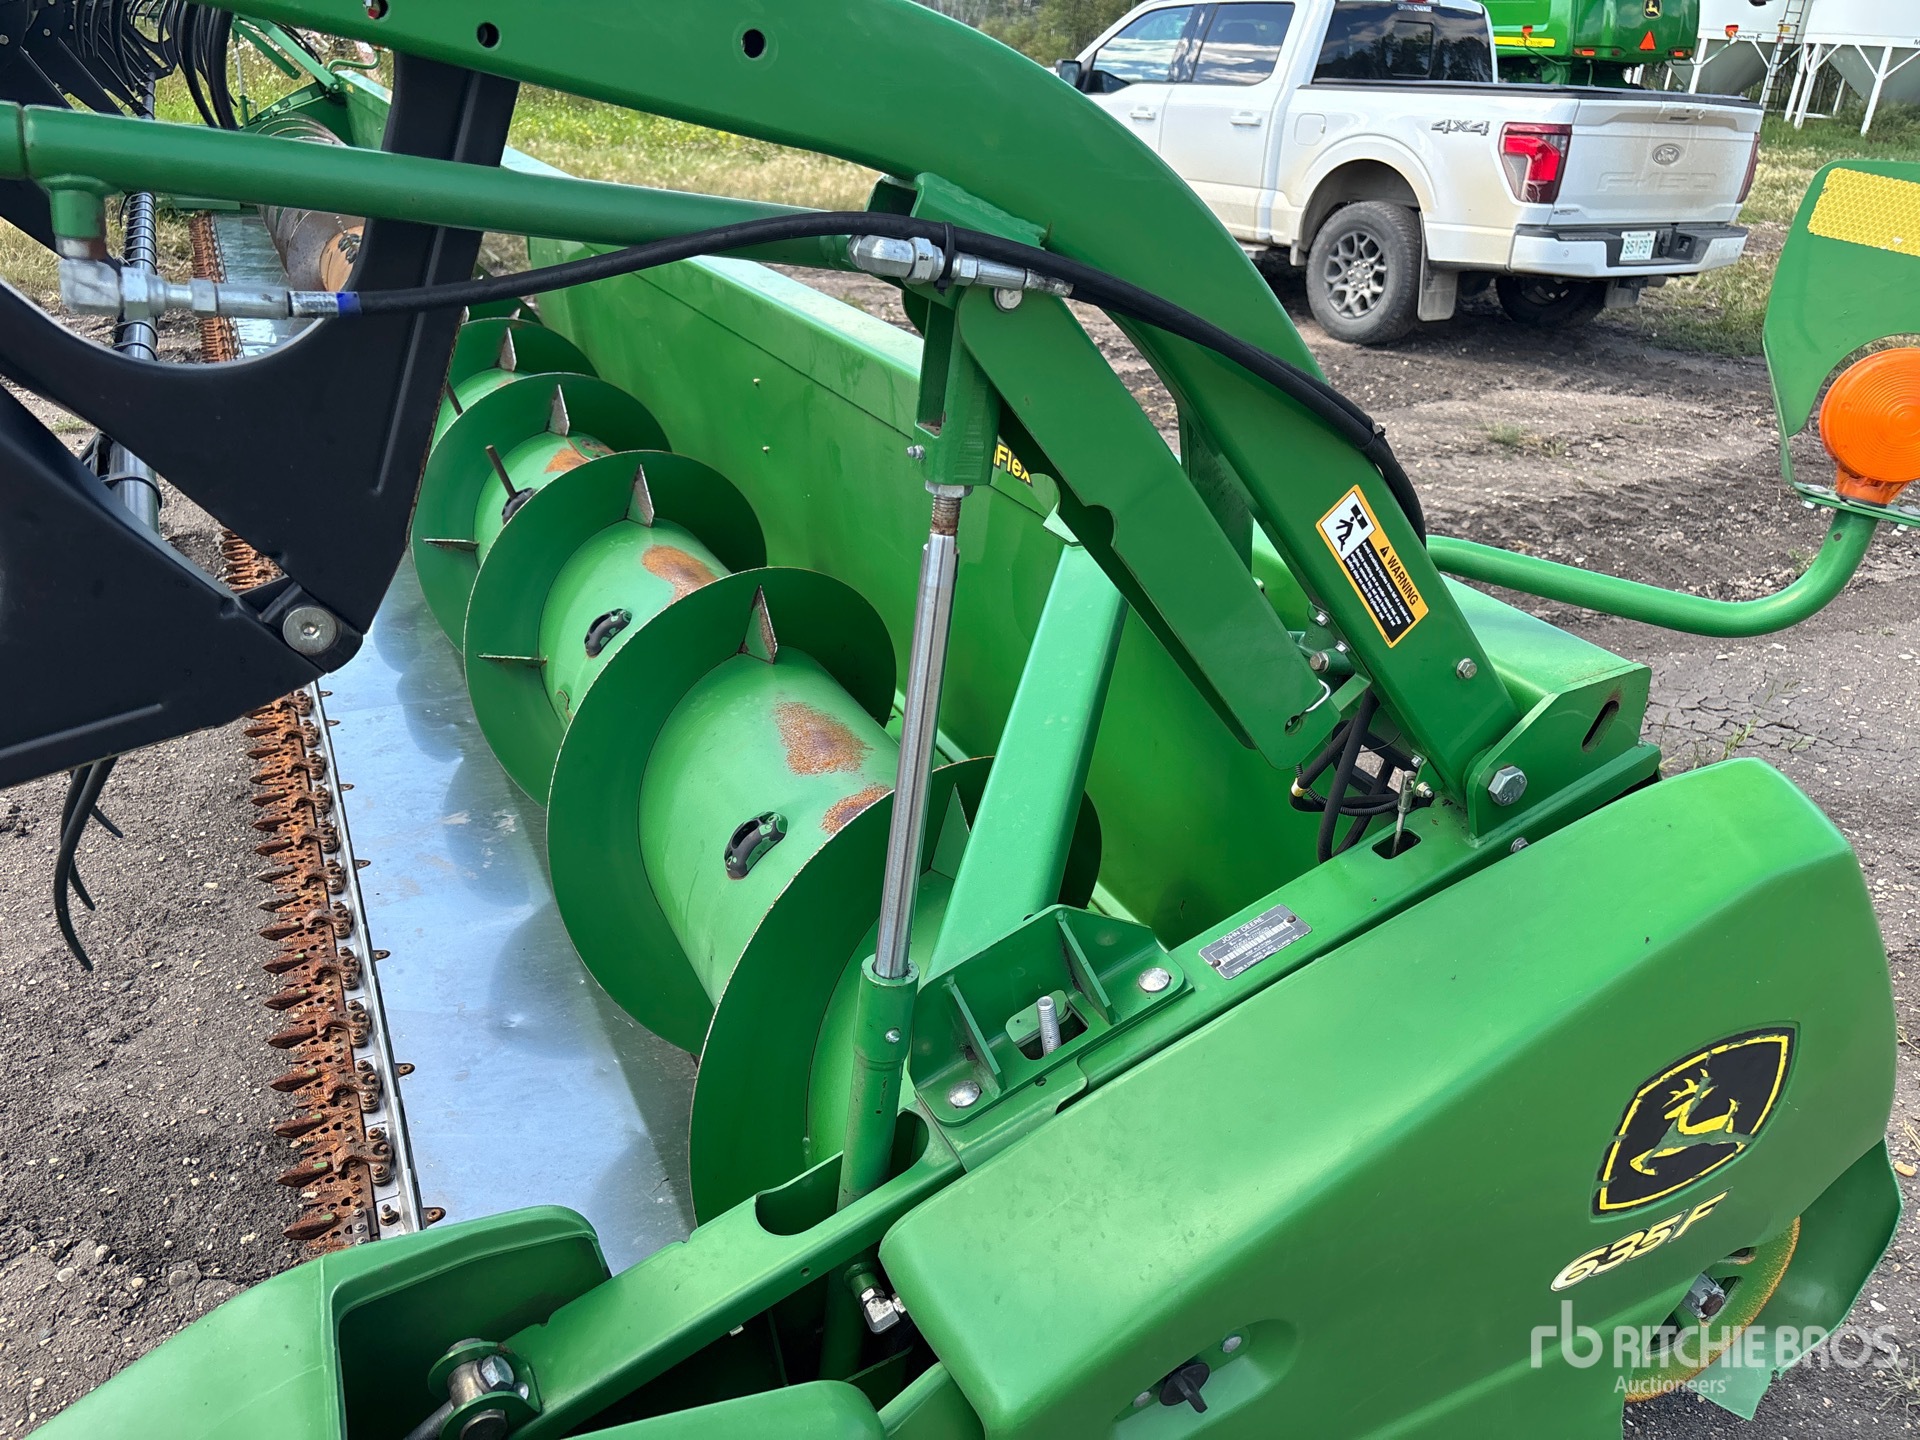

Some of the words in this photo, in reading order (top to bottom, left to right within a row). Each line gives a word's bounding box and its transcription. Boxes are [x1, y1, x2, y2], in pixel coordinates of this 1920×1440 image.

[1362, 542, 1371, 554] Avoid
[1368, 553, 1380, 571] crushing
[1363, 561, 1373, 578] working
[1388, 555, 1419, 606] WARNING
[1221, 930, 1240, 943] JOHN
[1240, 916, 1264, 932] DEERE
